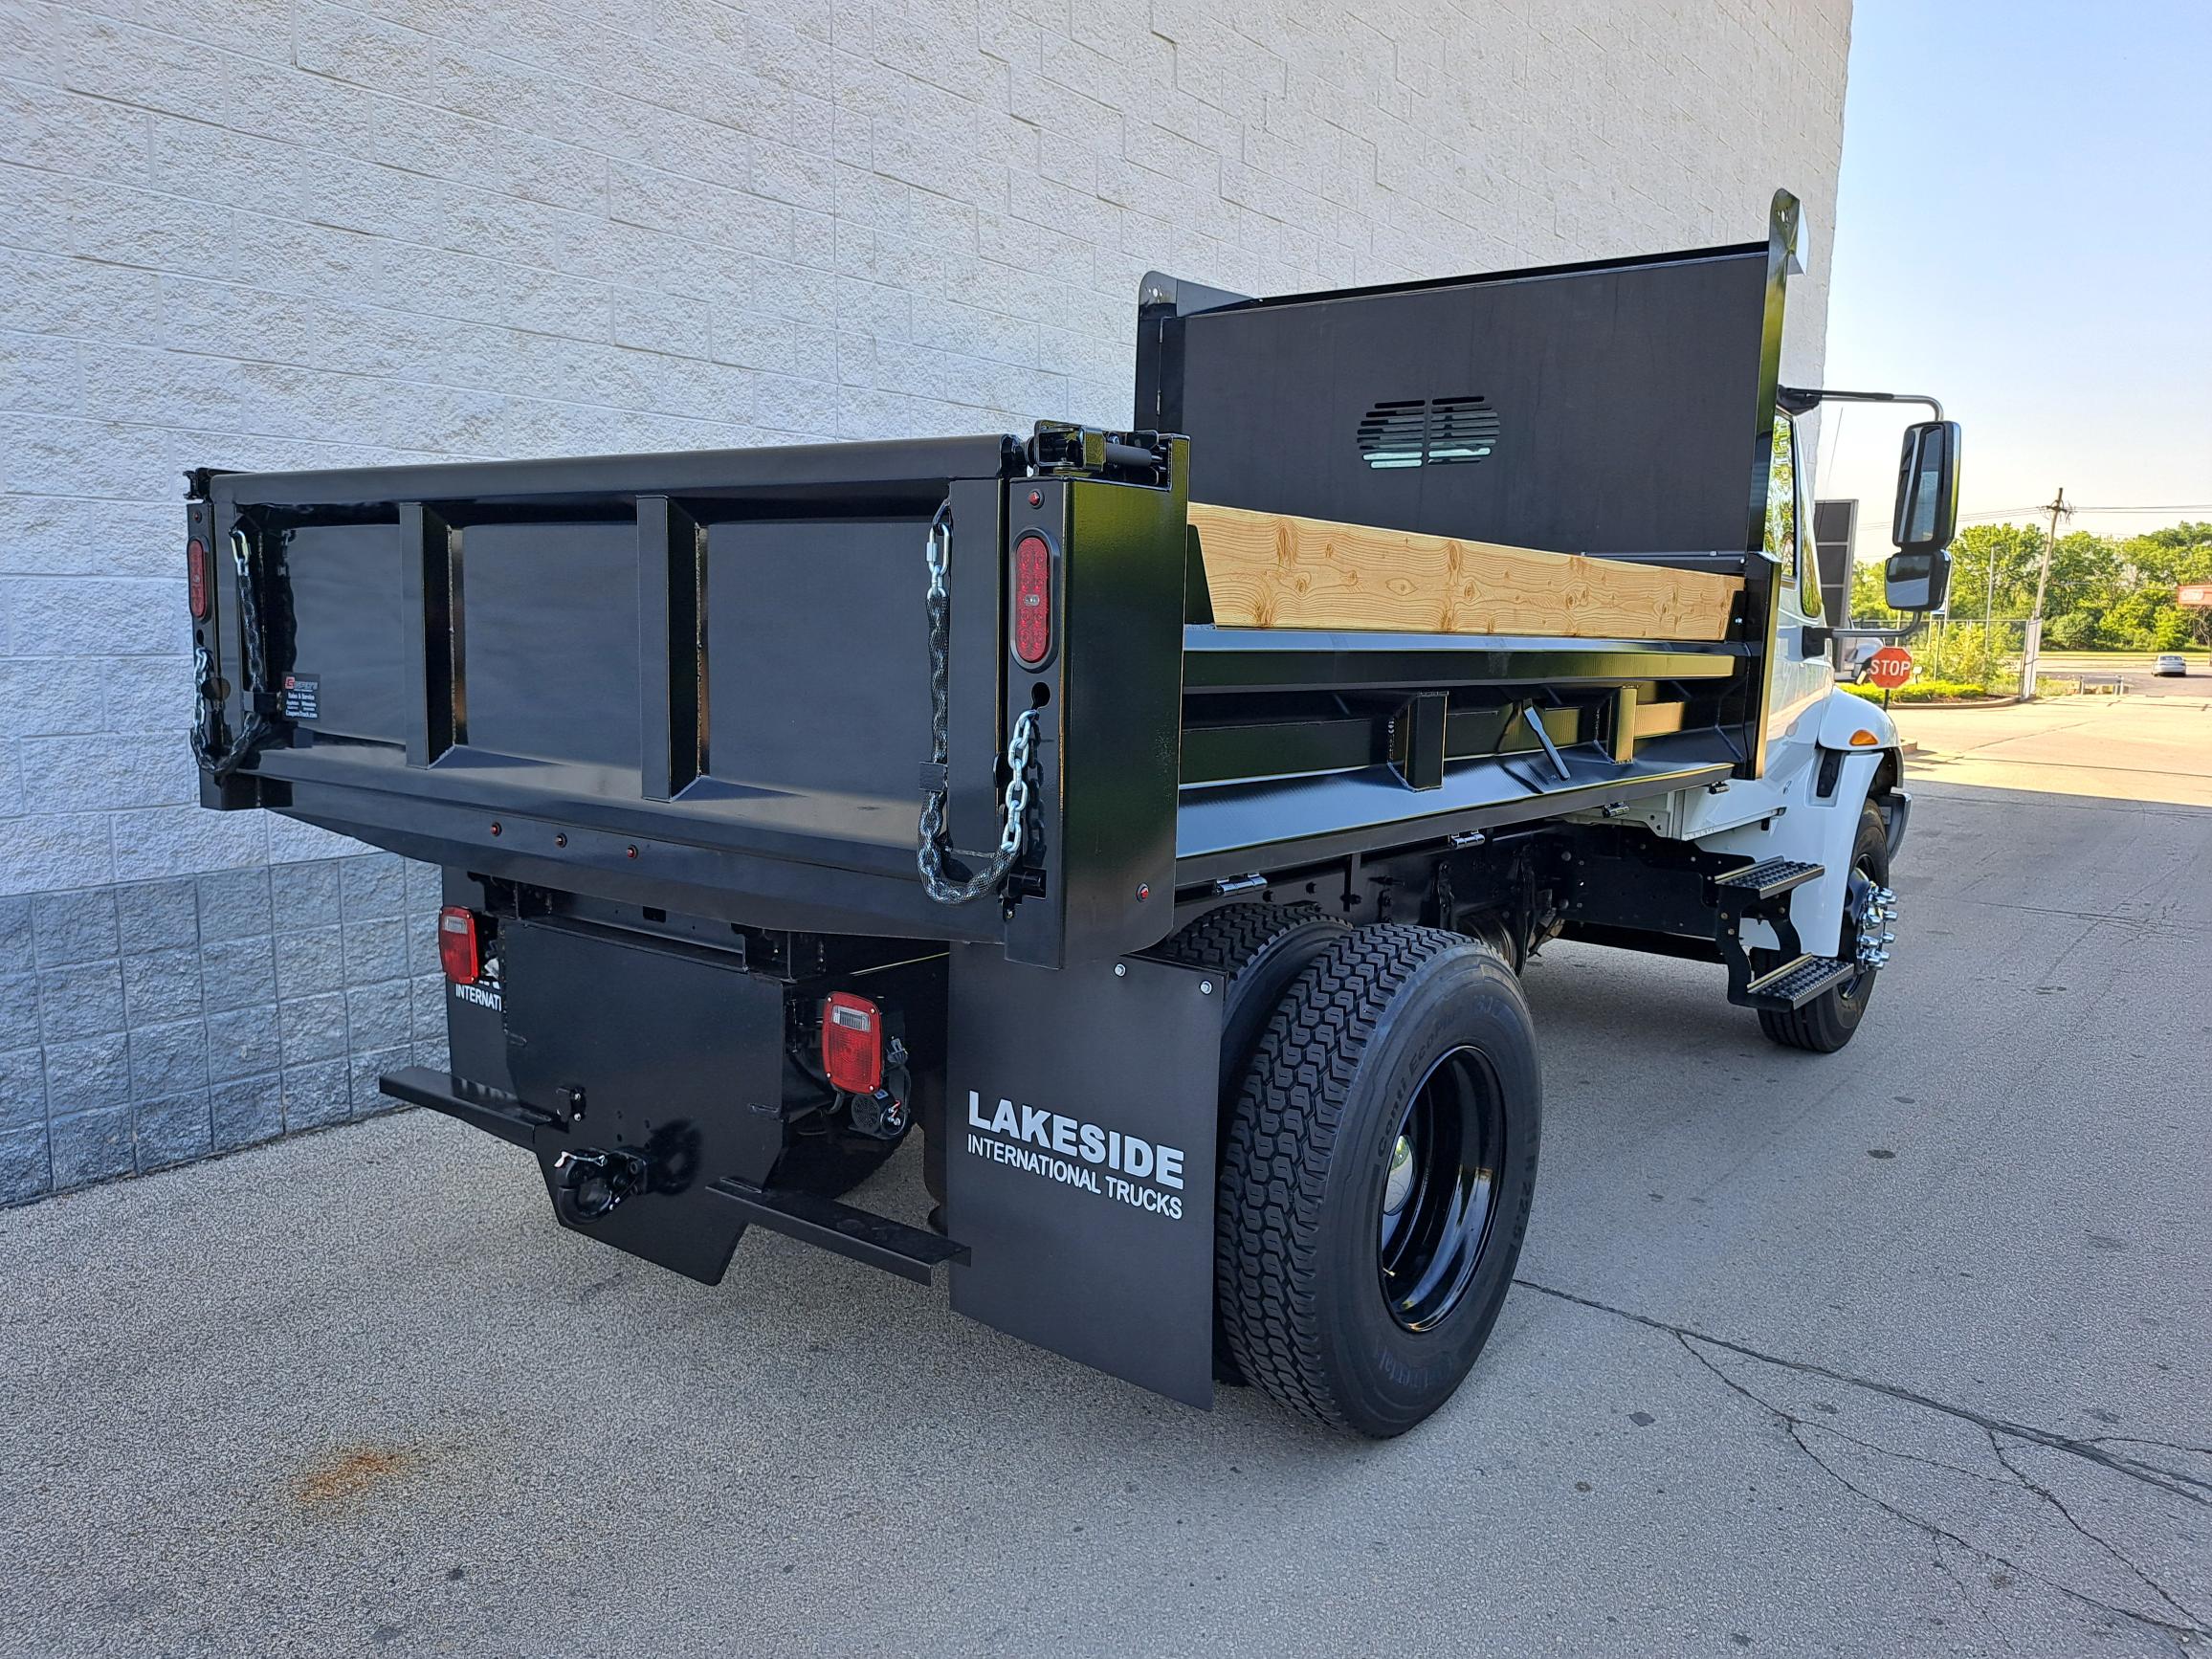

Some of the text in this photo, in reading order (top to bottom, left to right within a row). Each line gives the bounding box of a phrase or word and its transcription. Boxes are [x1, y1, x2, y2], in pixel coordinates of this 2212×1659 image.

[1869, 659, 1911, 676] STOP
[455, 983, 502, 1012] INTERNATI
[968, 1090, 1184, 1190] LAKESIDE
[967, 1133, 1183, 1220] INTERNATIONAL TRUCKS
